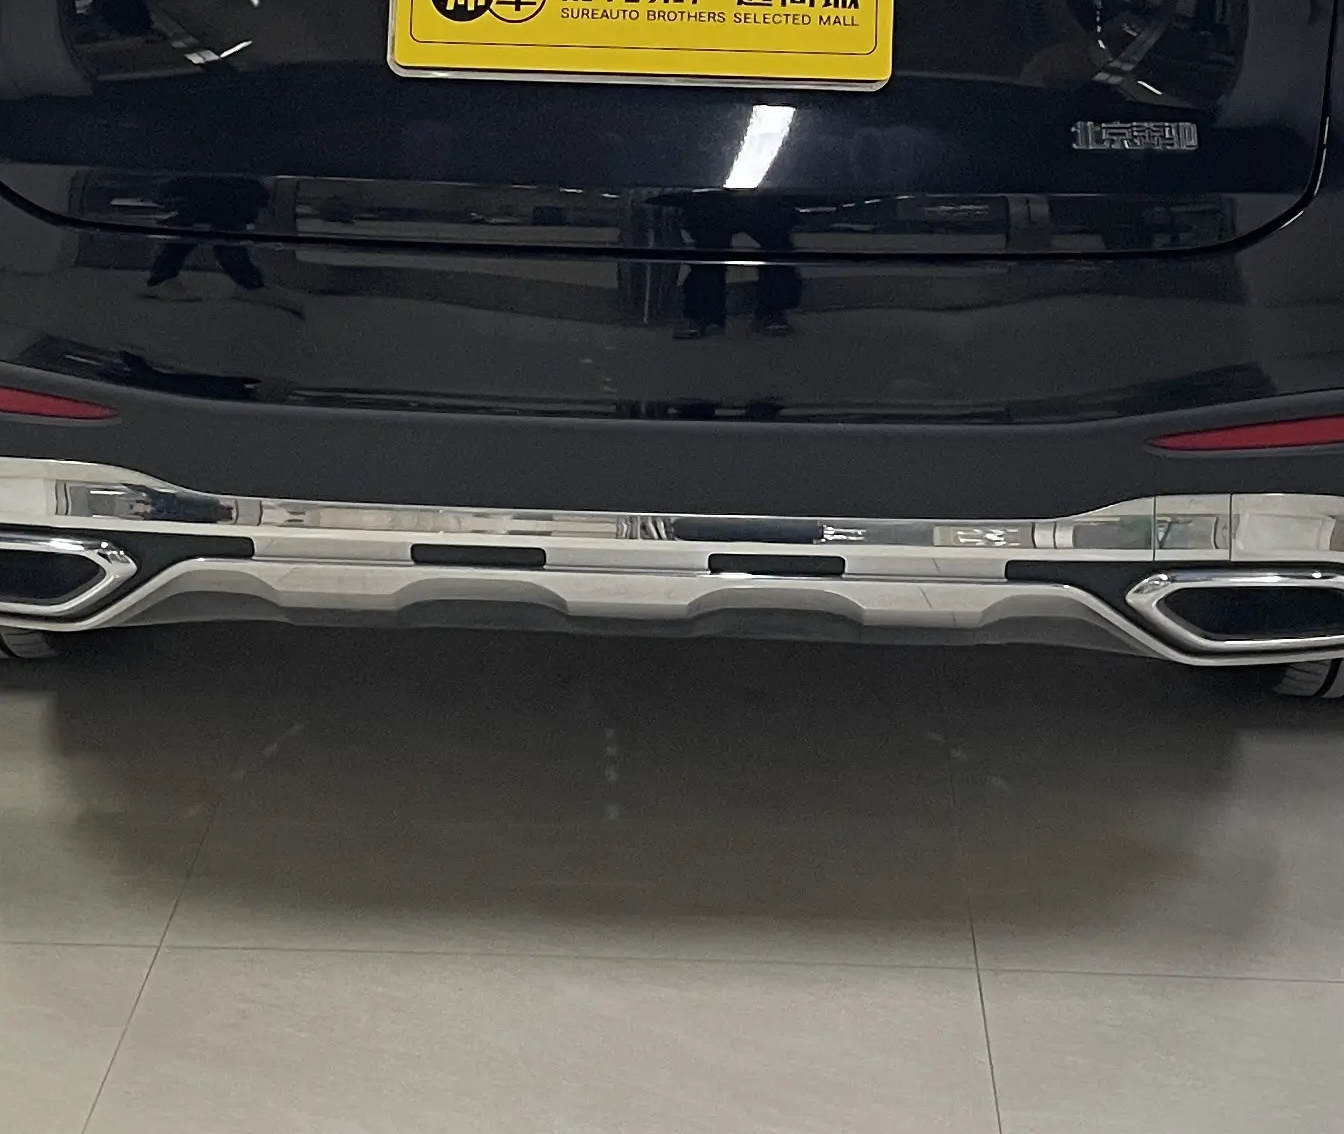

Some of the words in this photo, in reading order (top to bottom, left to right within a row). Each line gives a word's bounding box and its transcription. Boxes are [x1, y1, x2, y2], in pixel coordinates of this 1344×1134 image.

[561, 7, 639, 20] SUREAUTO
[647, 10, 726, 23] BROTHERS
[733, 12, 812, 25] SELECTED
[819, 14, 860, 27] MALL
